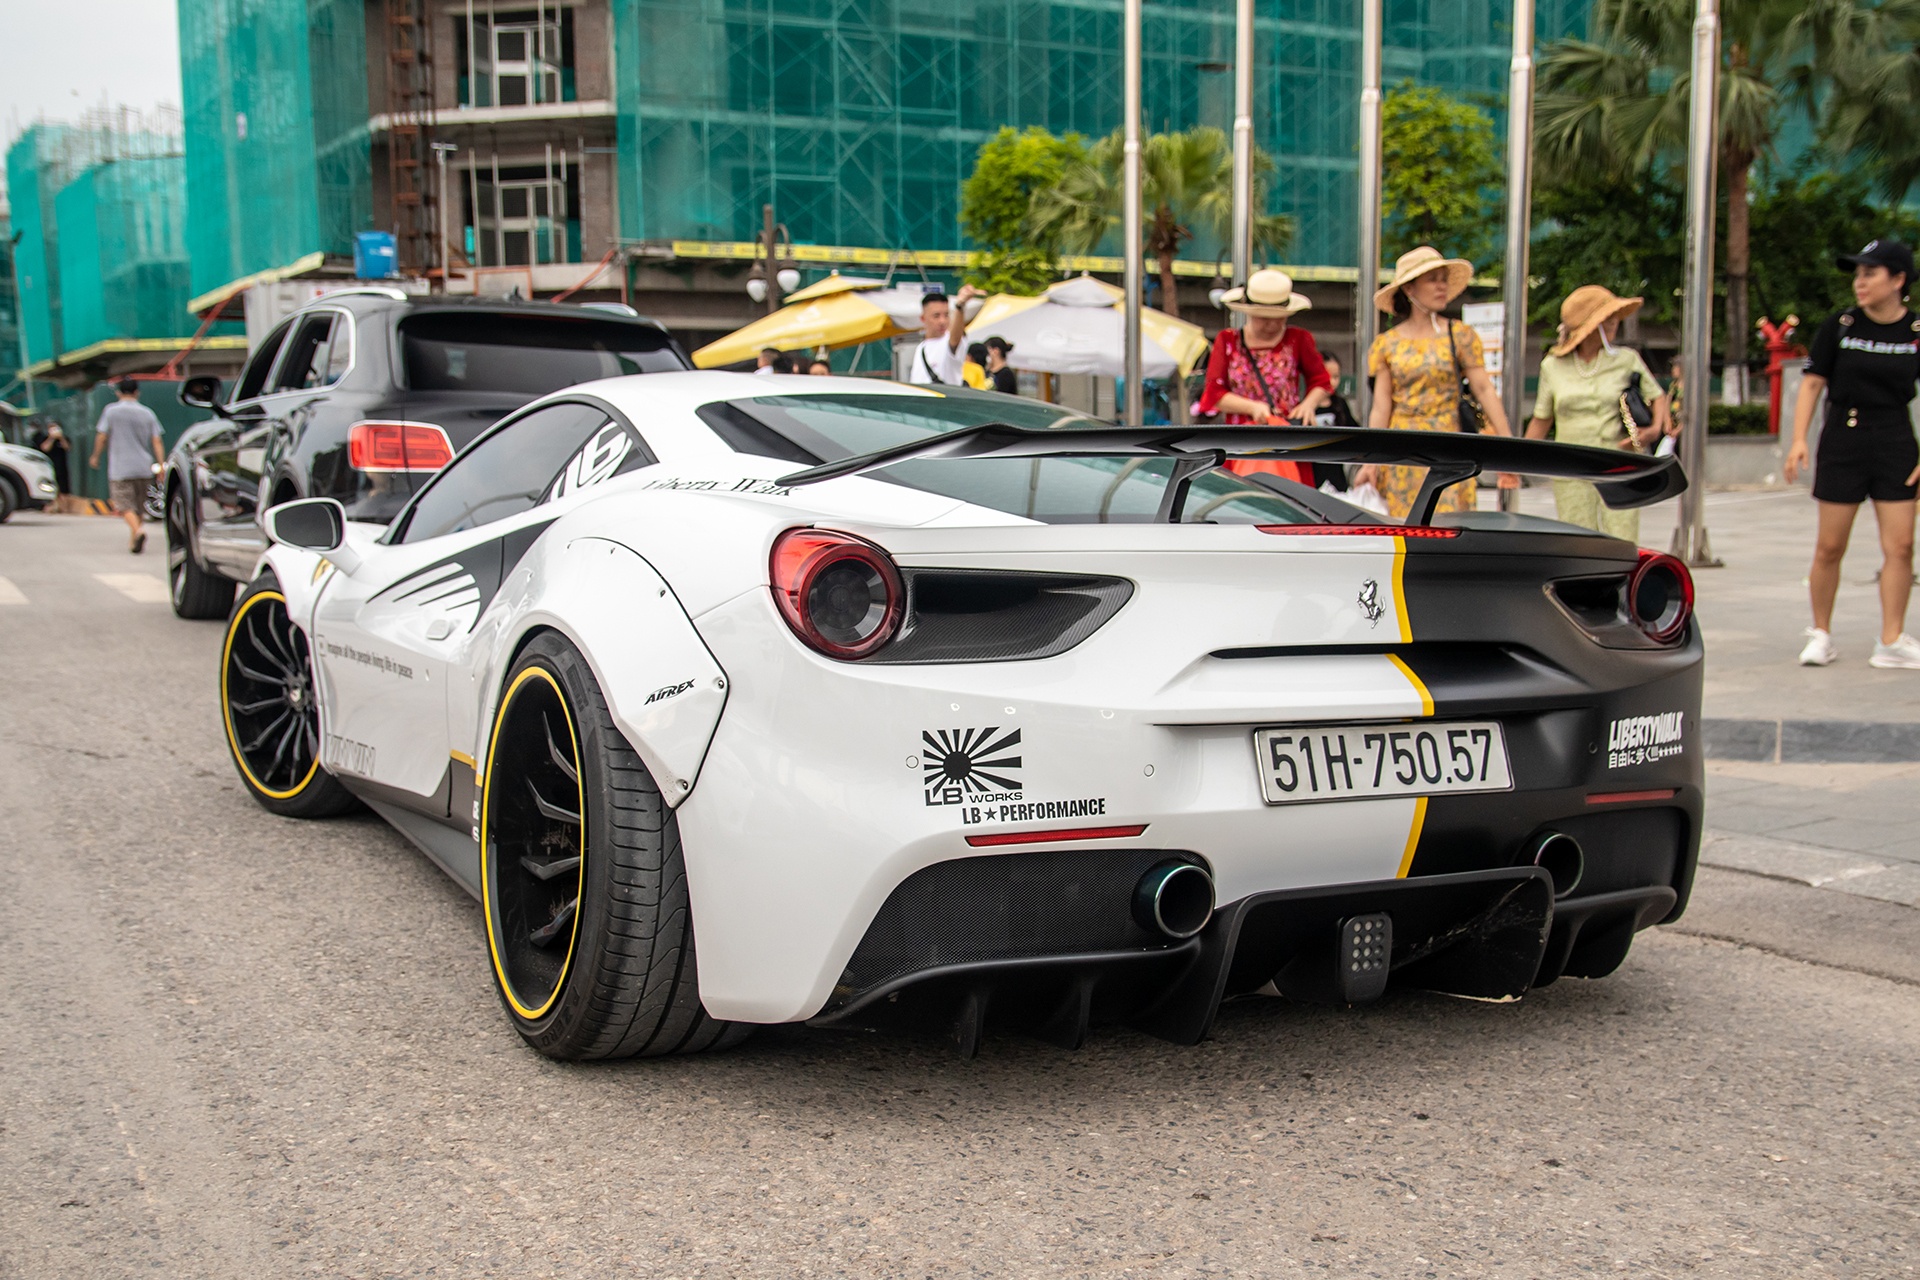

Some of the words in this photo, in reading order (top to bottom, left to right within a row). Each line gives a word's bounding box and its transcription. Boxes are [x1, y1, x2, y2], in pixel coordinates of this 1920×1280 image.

[1269, 728, 1492, 792] 51H-750.57
[924, 787, 964, 806] LB
[969, 791, 1023, 804] WORKS
[962, 807, 982, 825] LB
[1000, 798, 1106, 822] PERFORMANCE
